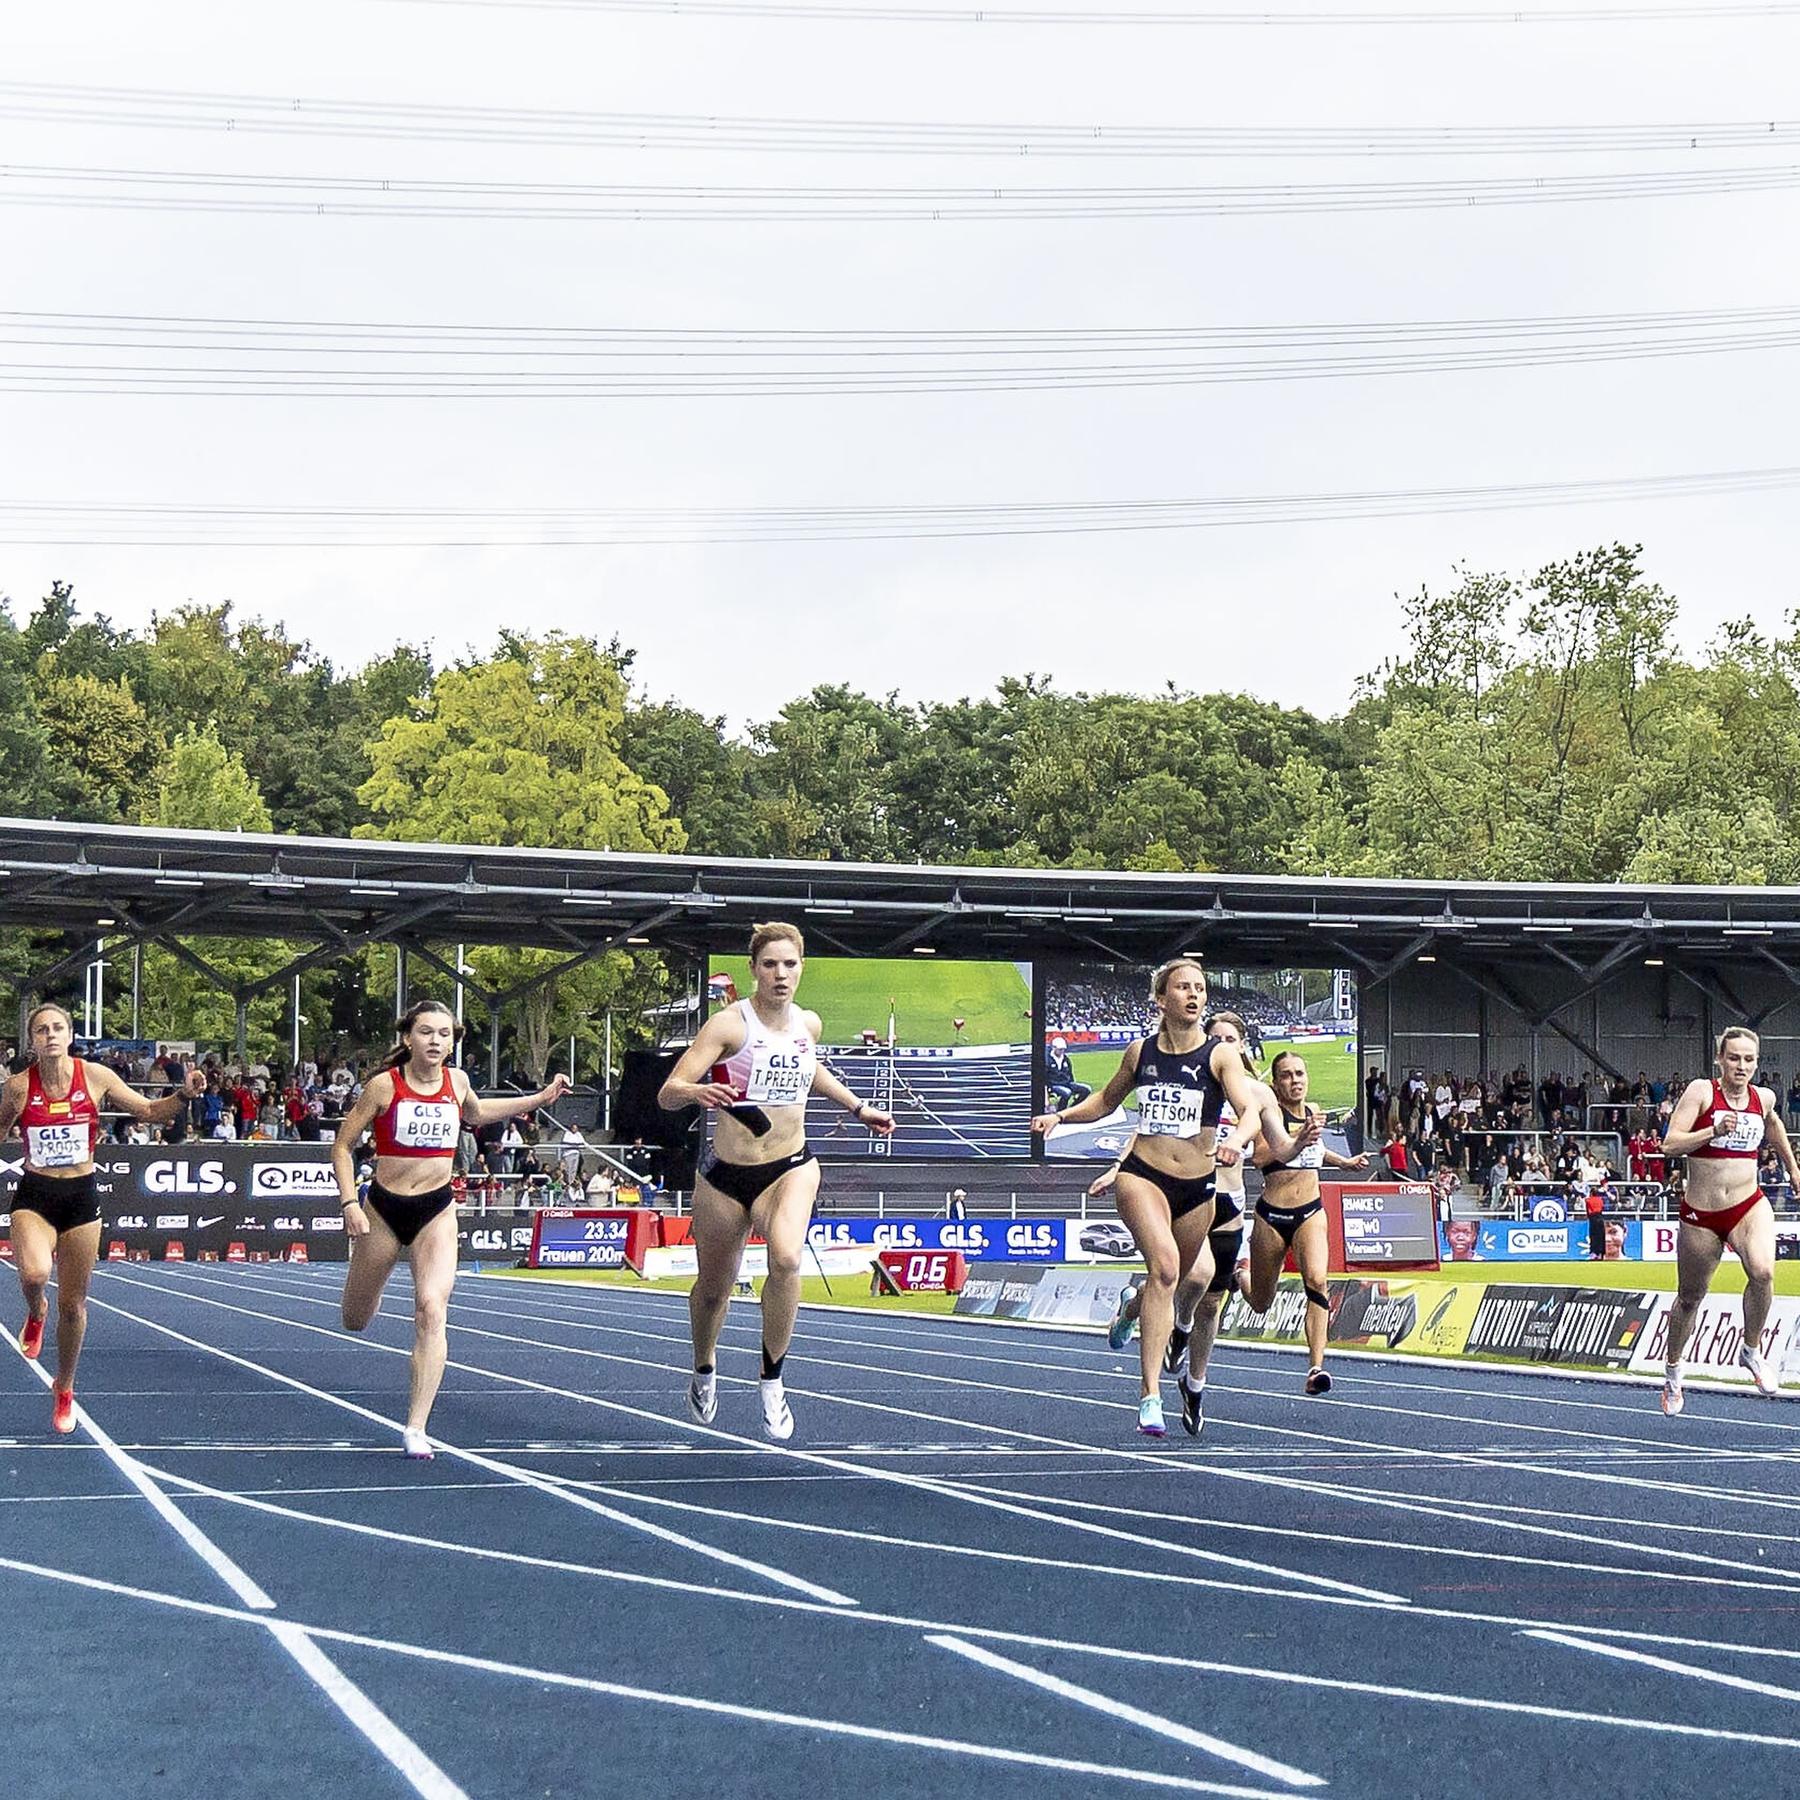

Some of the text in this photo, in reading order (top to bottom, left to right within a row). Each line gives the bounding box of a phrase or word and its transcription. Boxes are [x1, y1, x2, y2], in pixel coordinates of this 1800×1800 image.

[769, 1054, 800, 1069] GLS
[1148, 1089, 1182, 1104] GLS
[414, 1106, 443, 1118] GLS
[39, 1128, 71, 1140] GLS
[408, 1121, 452, 1137] BOER
[144, 1160, 238, 1194] GLS.
[1374, 1198, 1384, 1212] C
[117, 1215, 149, 1228] GLS.
[273, 1217, 304, 1230] GLS.
[584, 1221, 628, 1240] 23.34
[873, 1224, 923, 1248] GLS.
[939, 1224, 990, 1248] GLS.
[1006, 1225, 1058, 1248] GLS.
[1533, 1234, 1565, 1243] PLAN
[471, 1229, 508, 1250] GLS.
[539, 1245, 586, 1263] Frauen
[1384, 1242, 1394, 1258] 2
